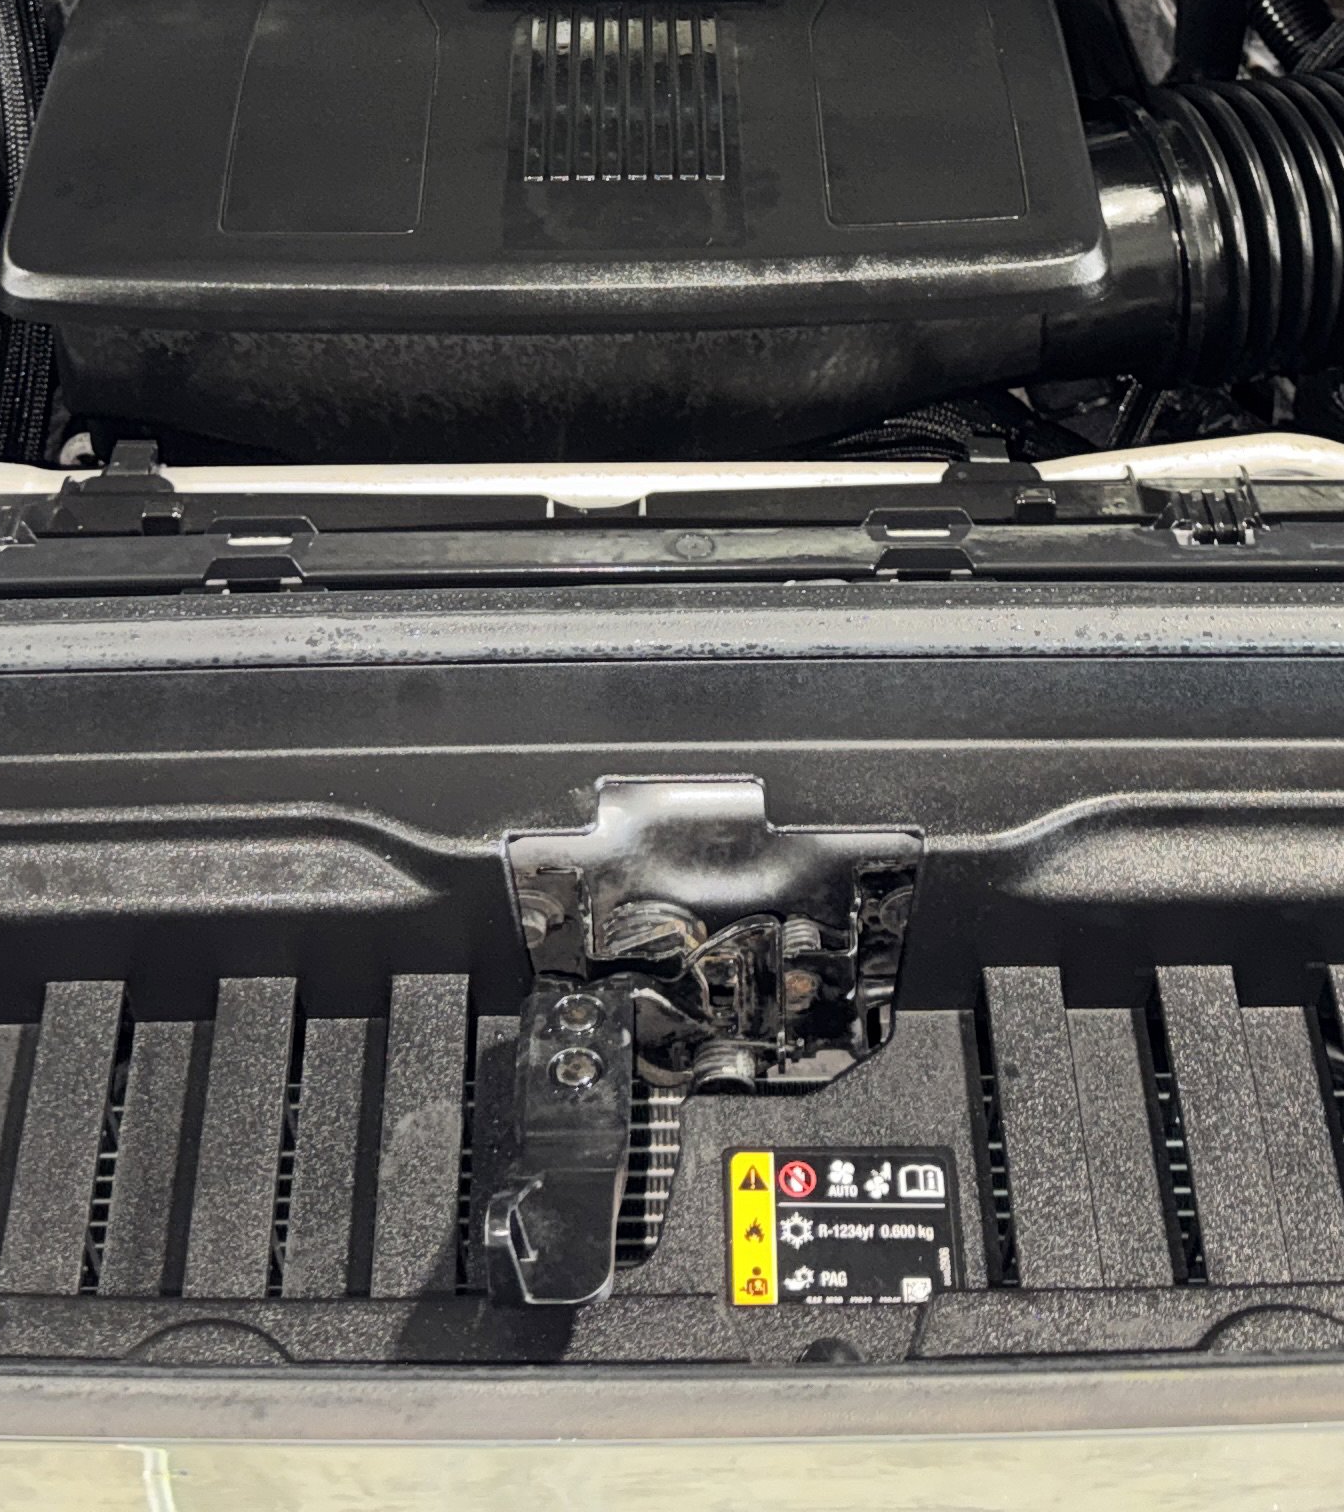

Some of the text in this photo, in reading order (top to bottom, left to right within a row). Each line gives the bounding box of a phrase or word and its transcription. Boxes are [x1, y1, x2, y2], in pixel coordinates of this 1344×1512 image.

[827, 1184, 858, 1198] AUTO
[817, 1223, 875, 1241] R-1234yf
[918, 1223, 935, 1242] kg
[820, 1270, 848, 1288] PAG
